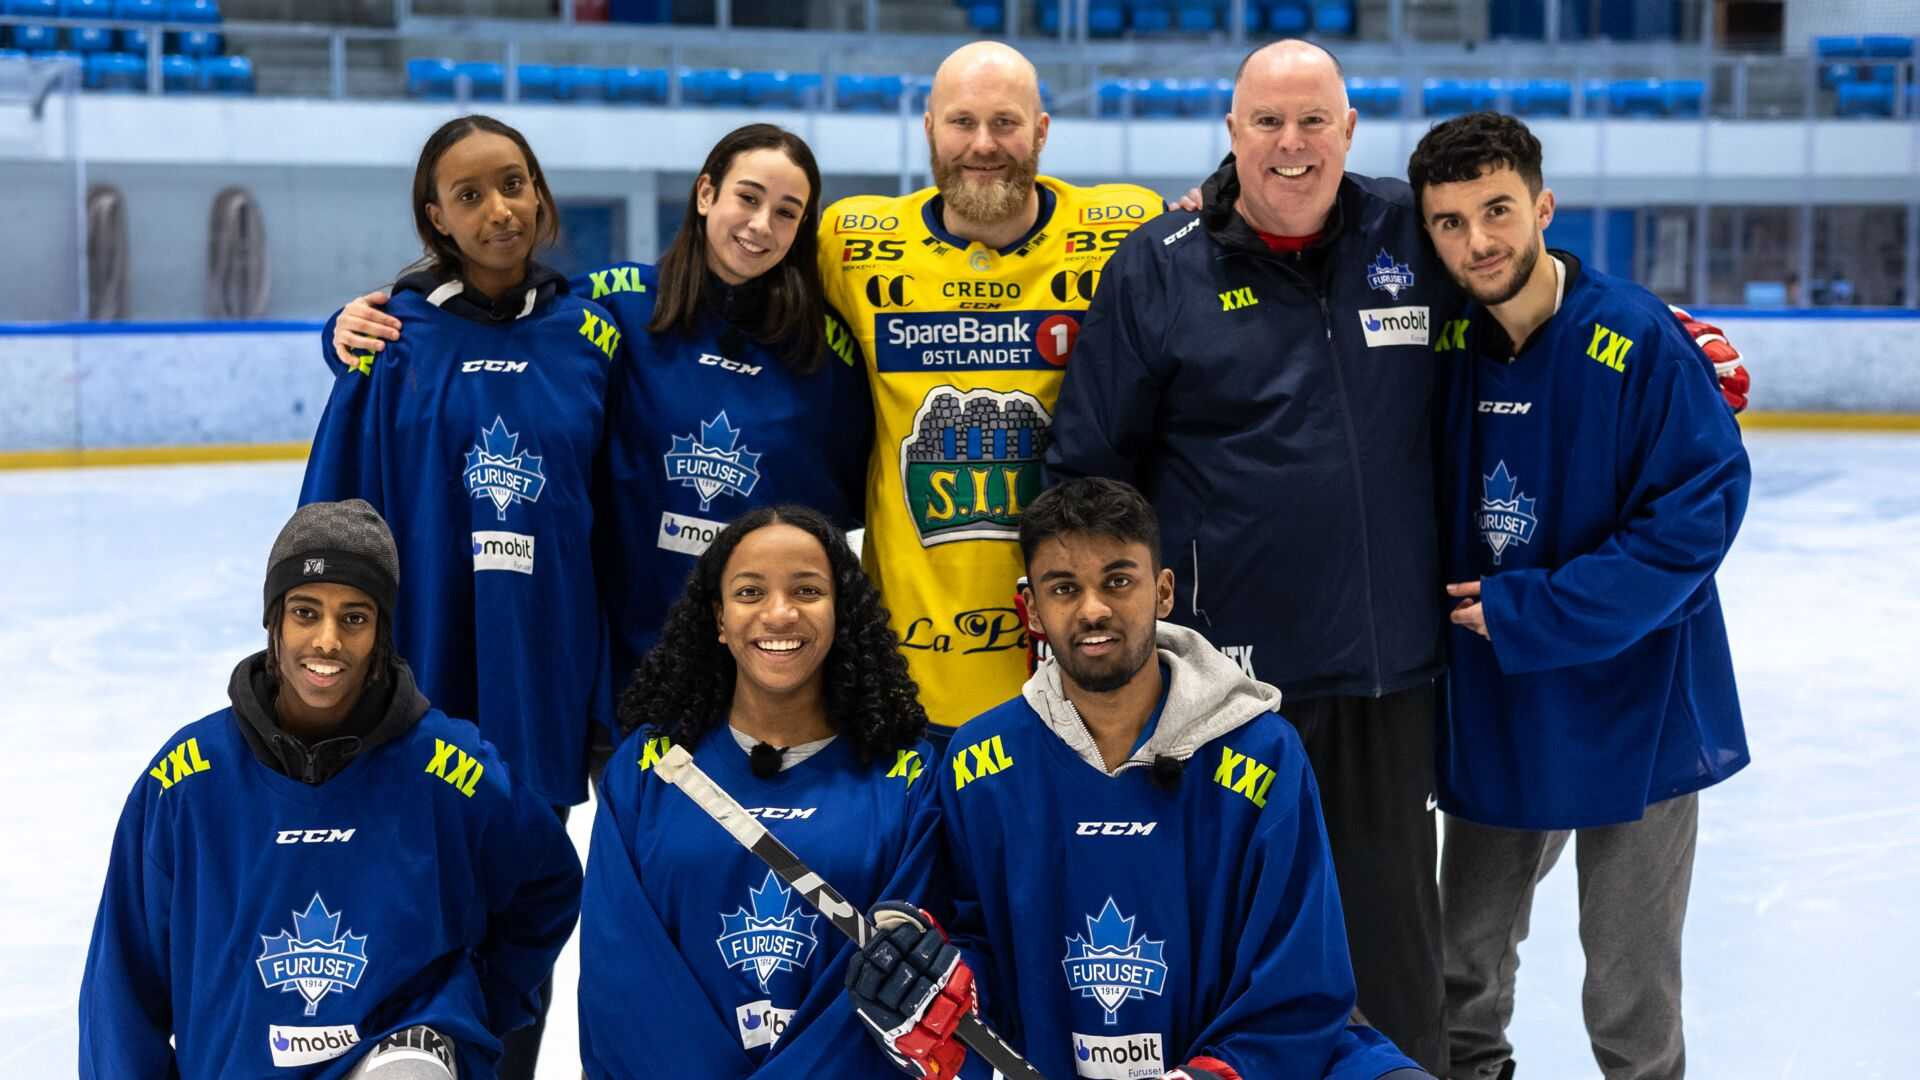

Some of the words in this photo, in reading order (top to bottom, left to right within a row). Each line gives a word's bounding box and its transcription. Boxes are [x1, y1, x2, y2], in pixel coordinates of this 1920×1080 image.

[843, 214, 899, 231] BDO
[1087, 204, 1145, 220] BDO
[1163, 217, 1201, 246] CCM
[588, 267, 646, 299] XXL
[942, 282, 1022, 299] CREDO
[1372, 274, 1408, 286] FURUSET
[1218, 287, 1259, 311] XXL
[1382, 311, 1427, 331] mobit
[888, 316, 1031, 349] SpareBank
[1050, 323, 1068, 356] 1
[922, 349, 1033, 365] ØSTLANDET
[1586, 323, 1633, 373] XXL
[462, 360, 528, 373] CCM
[698, 353, 763, 376] CCM
[1478, 401, 1532, 414] CCM
[469, 468, 532, 493] FURUSET
[676, 459, 747, 486] FURUSET
[484, 537, 532, 559] mobit
[898, 618, 953, 653] La
[149, 737, 211, 789] XXL
[425, 738, 485, 798] XXL
[953, 735, 1014, 791] XXL
[1213, 746, 1277, 808] XXL
[276, 828, 356, 844] CCM
[1076, 821, 1158, 836] CCM
[731, 935, 804, 959] FURUSET
[273, 957, 355, 980] FURUSET
[1073, 964, 1154, 986] FURUSET
[1101, 986, 1120, 995] 1914
[291, 1030, 356, 1052] mobit
[1091, 1038, 1160, 1064] mobit
